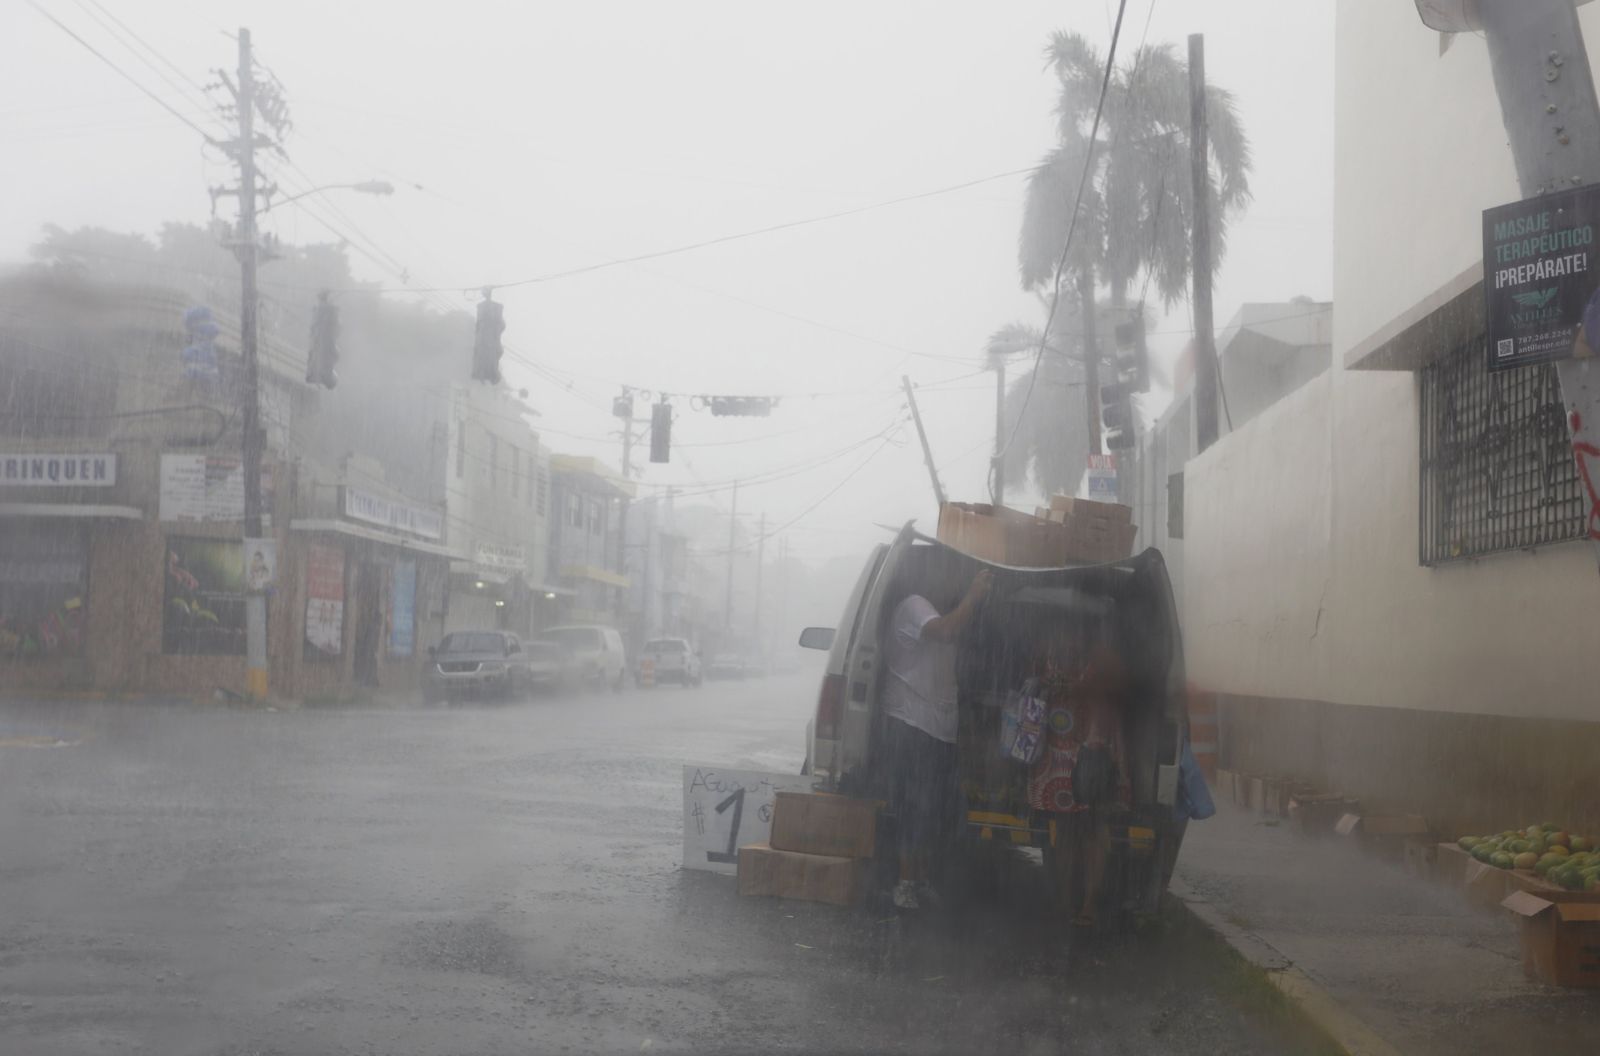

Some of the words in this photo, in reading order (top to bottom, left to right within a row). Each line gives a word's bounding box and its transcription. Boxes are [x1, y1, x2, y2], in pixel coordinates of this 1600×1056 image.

[1494, 211, 1550, 241] MASAJE
[1495, 224, 1593, 263] TERAPÉUTICO
[1495, 252, 1588, 289] ¡PREPÁRATE!
[0, 459, 105, 482] RINQUEN
